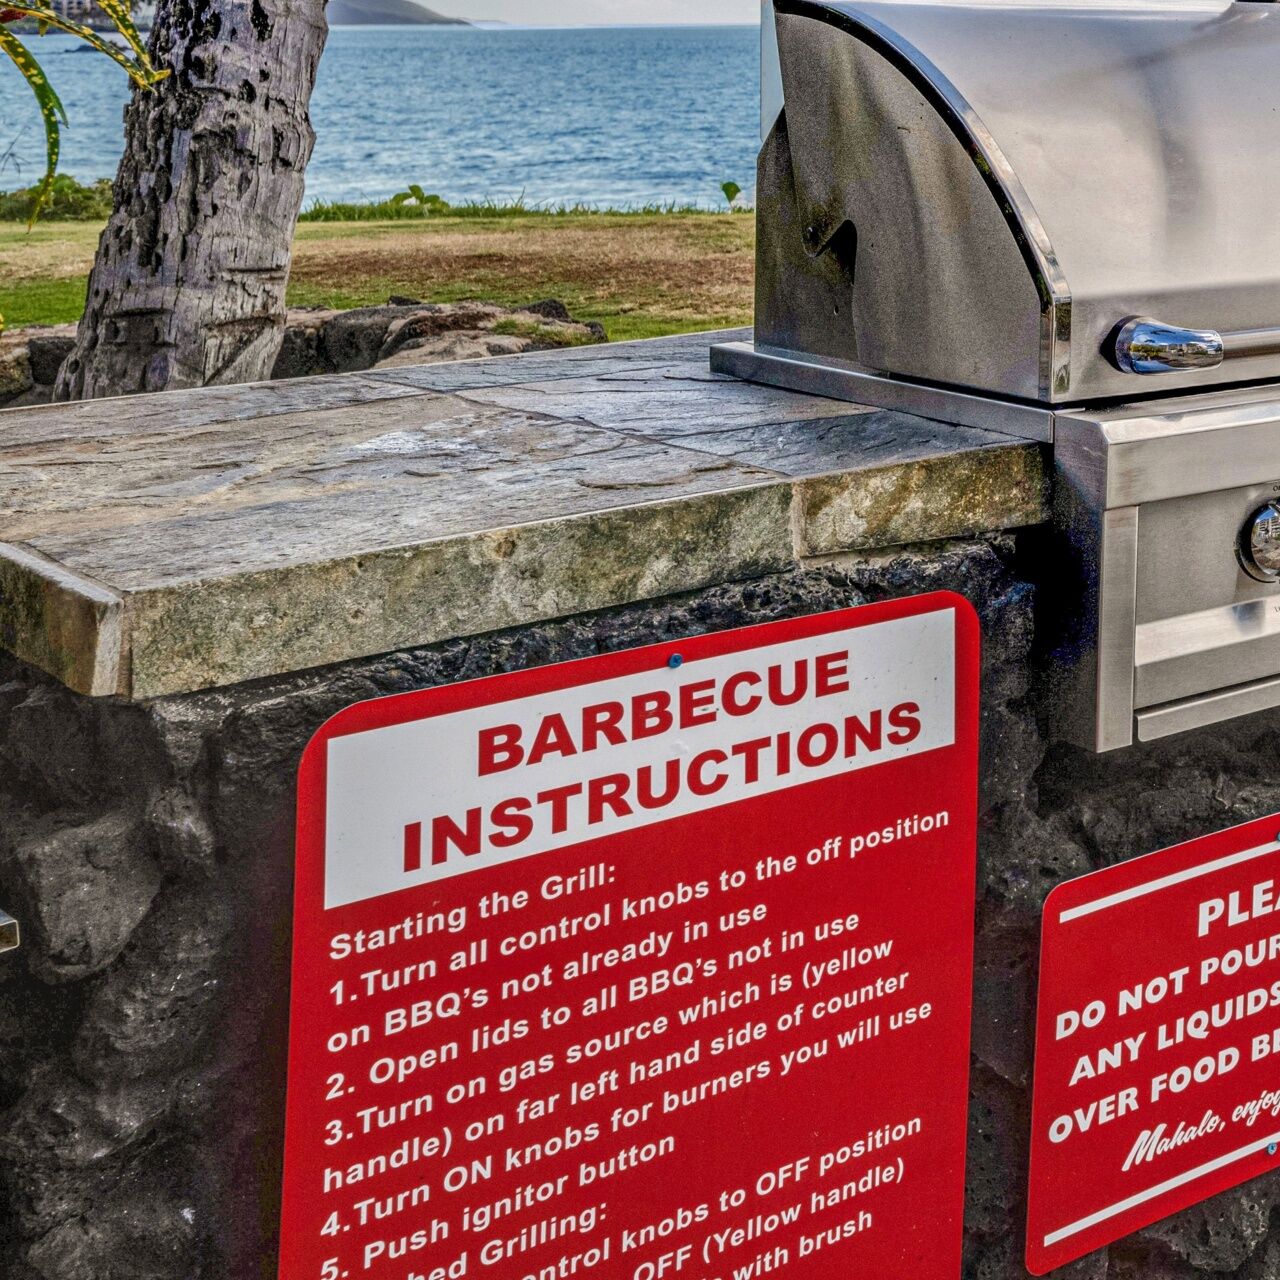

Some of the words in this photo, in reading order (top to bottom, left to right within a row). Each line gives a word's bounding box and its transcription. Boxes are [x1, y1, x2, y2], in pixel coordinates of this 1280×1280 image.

[479, 650, 849, 776] BARBECUE
[404, 702, 921, 872] INSTRUCTIONS
[330, 907, 465, 959] Starting
[479, 891, 528, 918] the
[541, 863, 614, 899] Grill:
[450, 939, 486, 970] all
[501, 904, 609, 955] control
[623, 881, 708, 920] knobs
[720, 871, 745, 891] to
[756, 856, 796, 880] the
[807, 837, 841, 864] off
[851, 812, 948, 858] position
[326, 1073, 354, 1100] 2.
[370, 1043, 457, 1083] Open
[473, 1019, 528, 1052] lids
[541, 1007, 570, 1029] to
[583, 986, 616, 1016] all
[729, 938, 771, 969] not
[782, 931, 803, 952] in
[815, 915, 858, 940] use
[328, 1025, 369, 1052] on
[502, 965, 552, 999] not
[564, 932, 672, 979] already
[685, 921, 707, 943] in
[720, 904, 766, 931] use
[447, 1077, 485, 1103] on
[499, 1055, 553, 1092] gas
[567, 1017, 667, 1063] source
[679, 983, 759, 1025] which
[771, 974, 792, 995] is
[803, 940, 892, 988] (yellow
[1056, 1001, 1105, 1040] DO
[1119, 967, 1189, 1016] NOT
[324, 1127, 451, 1192] handle)
[466, 1115, 503, 1140] on
[517, 1094, 559, 1123] far
[572, 1070, 618, 1105] left
[630, 1040, 699, 1084] hand
[711, 1022, 766, 1054] side
[778, 1004, 804, 1030] of
[812, 973, 908, 1018] counter
[444, 1156, 491, 1192] ON
[506, 1123, 599, 1171] knobs
[611, 1103, 653, 1132] for
[664, 1061, 770, 1113] burners
[781, 1040, 827, 1075] you
[838, 1016, 879, 1048] will
[890, 1003, 931, 1029] use
[1049, 1087, 1138, 1143] OVER
[1151, 1047, 1239, 1102] FOOD
[1069, 1032, 1146, 1086] ANY
[622, 1204, 708, 1252] knobs
[720, 1190, 745, 1211] to
[757, 1157, 809, 1195] OFF
[820, 1118, 920, 1176] position
[1122, 1110, 1225, 1171] Mahalo,
[321, 1257, 348, 1280] 5.
[365, 1219, 448, 1269] Push
[463, 1176, 568, 1231] ignitor
[580, 1137, 674, 1186] button
[481, 1203, 606, 1265] Grilling:
[634, 1245, 691, 1280] OFF
[703, 1204, 801, 1263] (Yellow
[811, 1158, 903, 1213] handle)
[733, 1247, 788, 1280] with
[800, 1211, 871, 1257] brush
